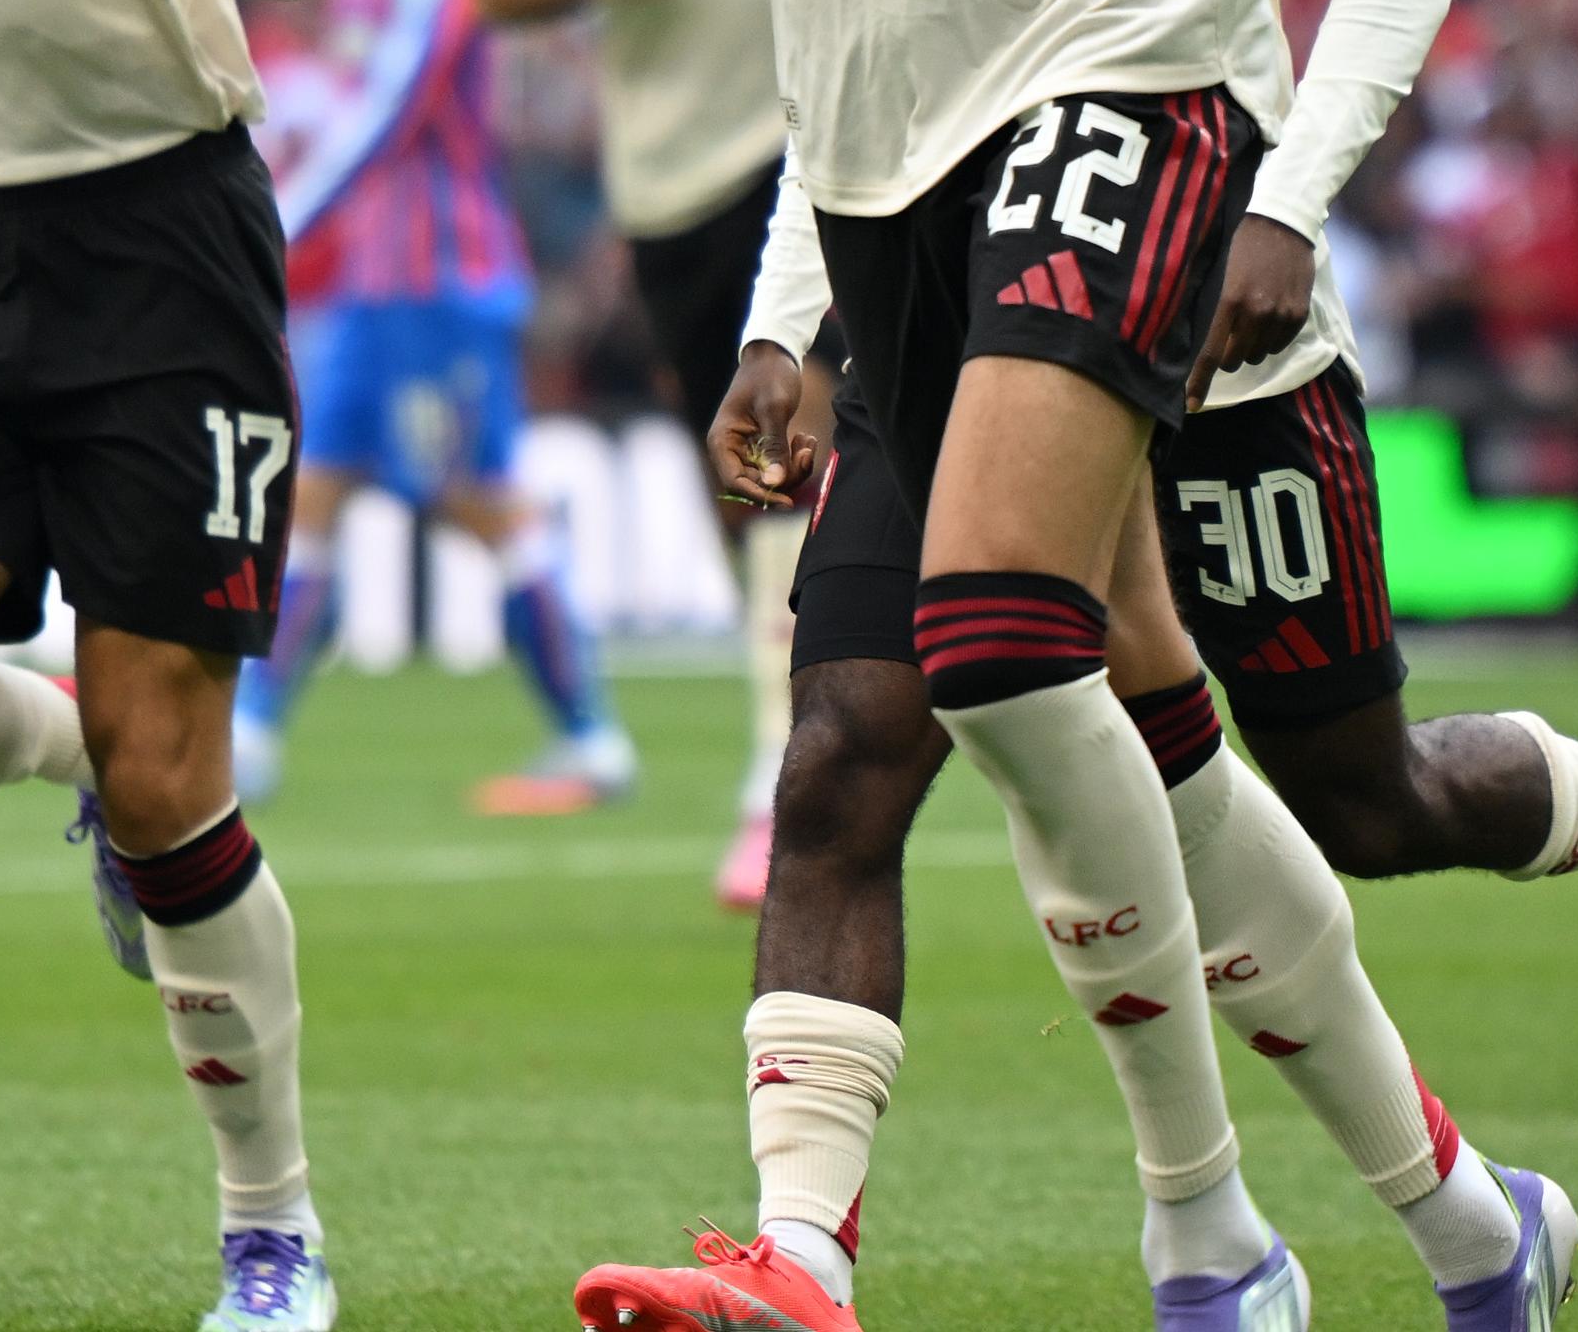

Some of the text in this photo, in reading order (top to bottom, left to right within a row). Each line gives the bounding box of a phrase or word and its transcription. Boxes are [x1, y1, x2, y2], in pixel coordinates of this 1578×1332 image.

[987, 100, 1150, 254] 22
[205, 407, 292, 543] 17
[1177, 468, 1331, 607] 30
[1044, 905, 1141, 947] LFC
